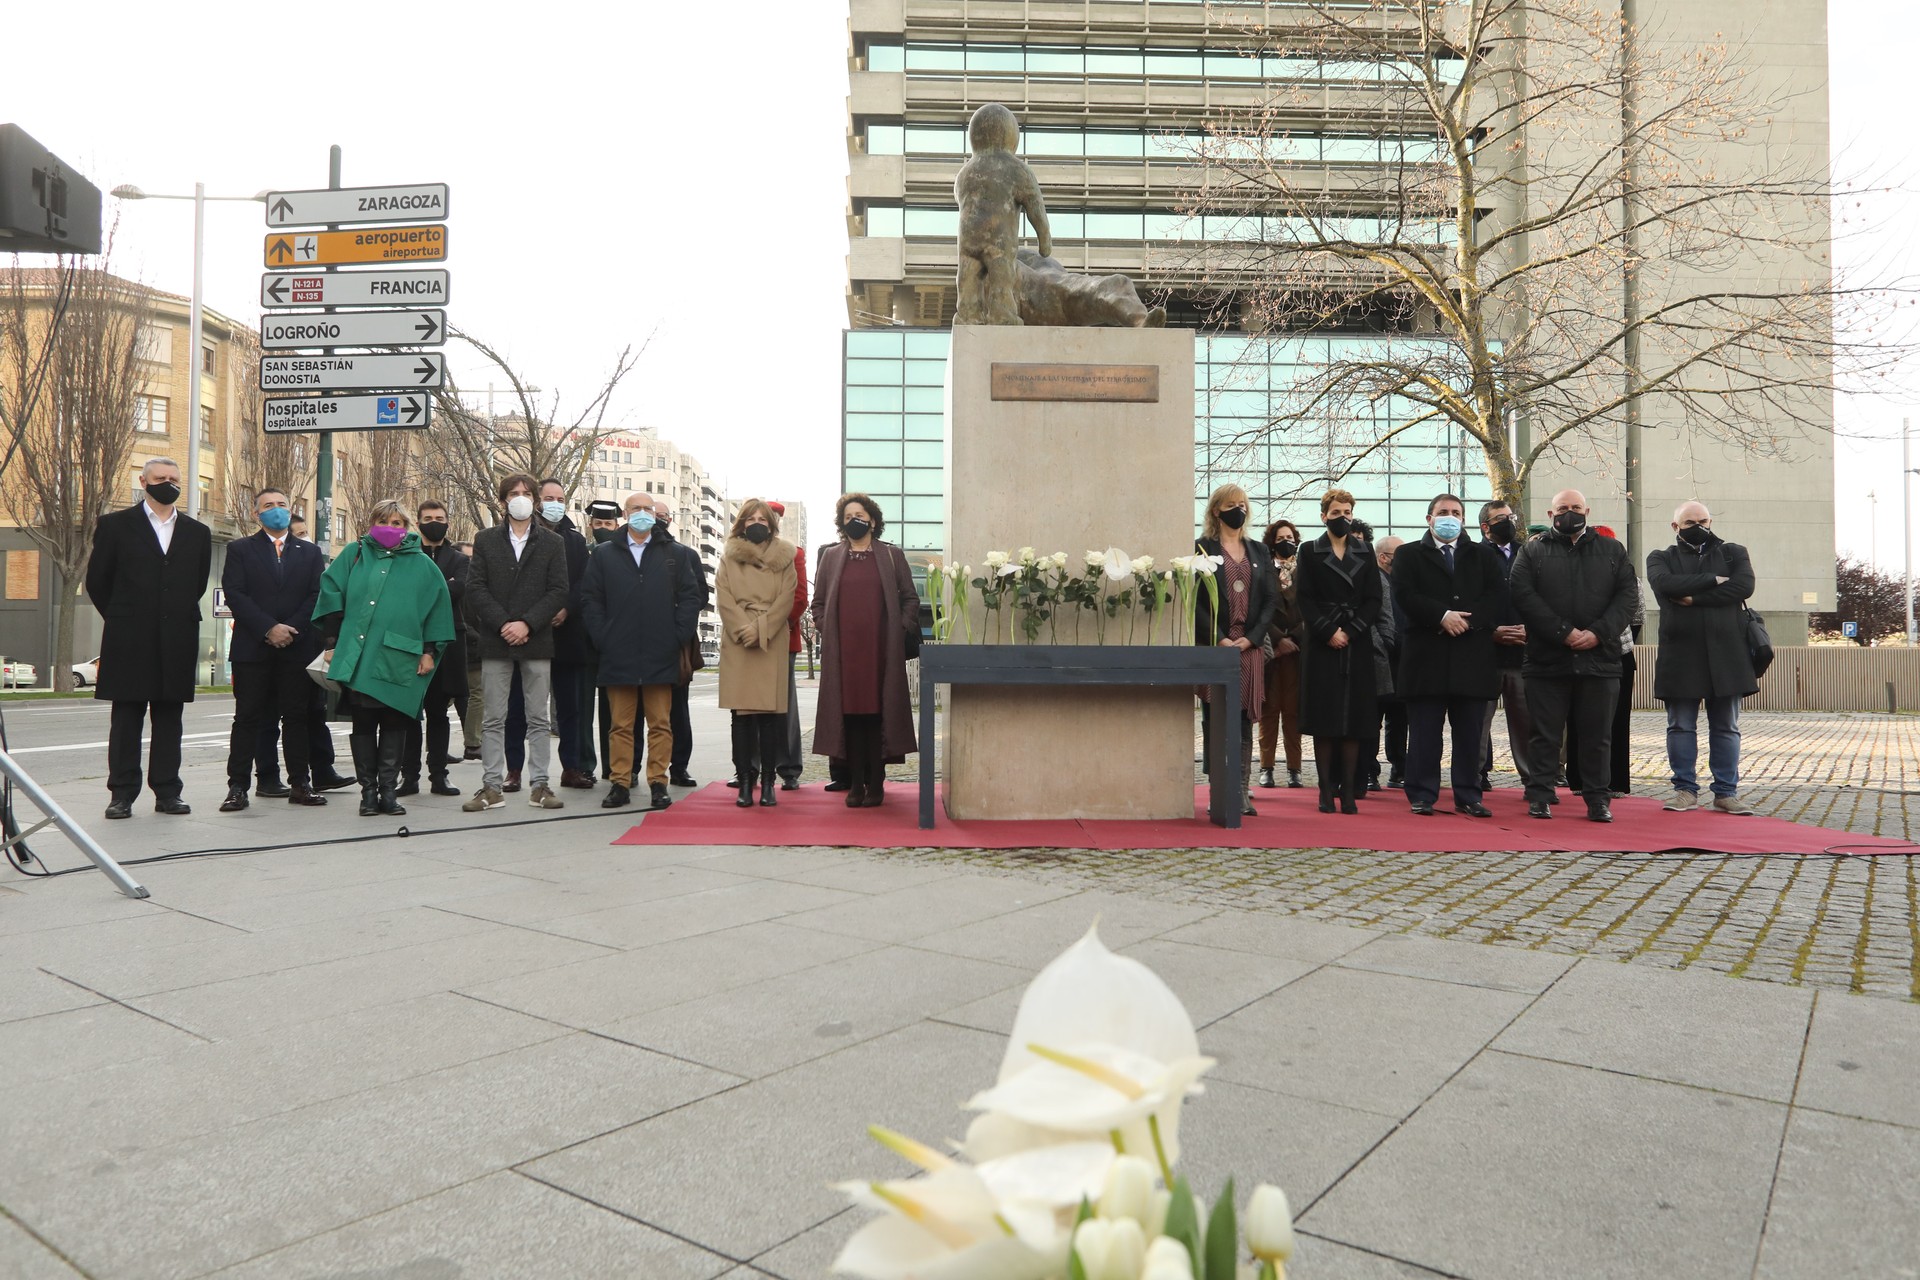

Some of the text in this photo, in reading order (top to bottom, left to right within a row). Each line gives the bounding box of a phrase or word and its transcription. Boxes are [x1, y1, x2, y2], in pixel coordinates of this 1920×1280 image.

[358, 194, 442, 212] ZARAGOZA
[355, 228, 441, 247] aeropuerto
[383, 246, 441, 259] aireportua
[370, 280, 442, 295] FRANCIA
[297, 292, 319, 300] N-135
[265, 321, 341, 340] LOGROÑO
[265, 357, 353, 372] SAN SEBASTIÁN
[264, 374, 321, 385] DONOSTIA
[267, 400, 338, 418] hospitales
[267, 416, 318, 428] ospitaleak
[605, 436, 615, 446] de
[617, 437, 641, 449] Salud
[1845, 623, 1855, 635] P
